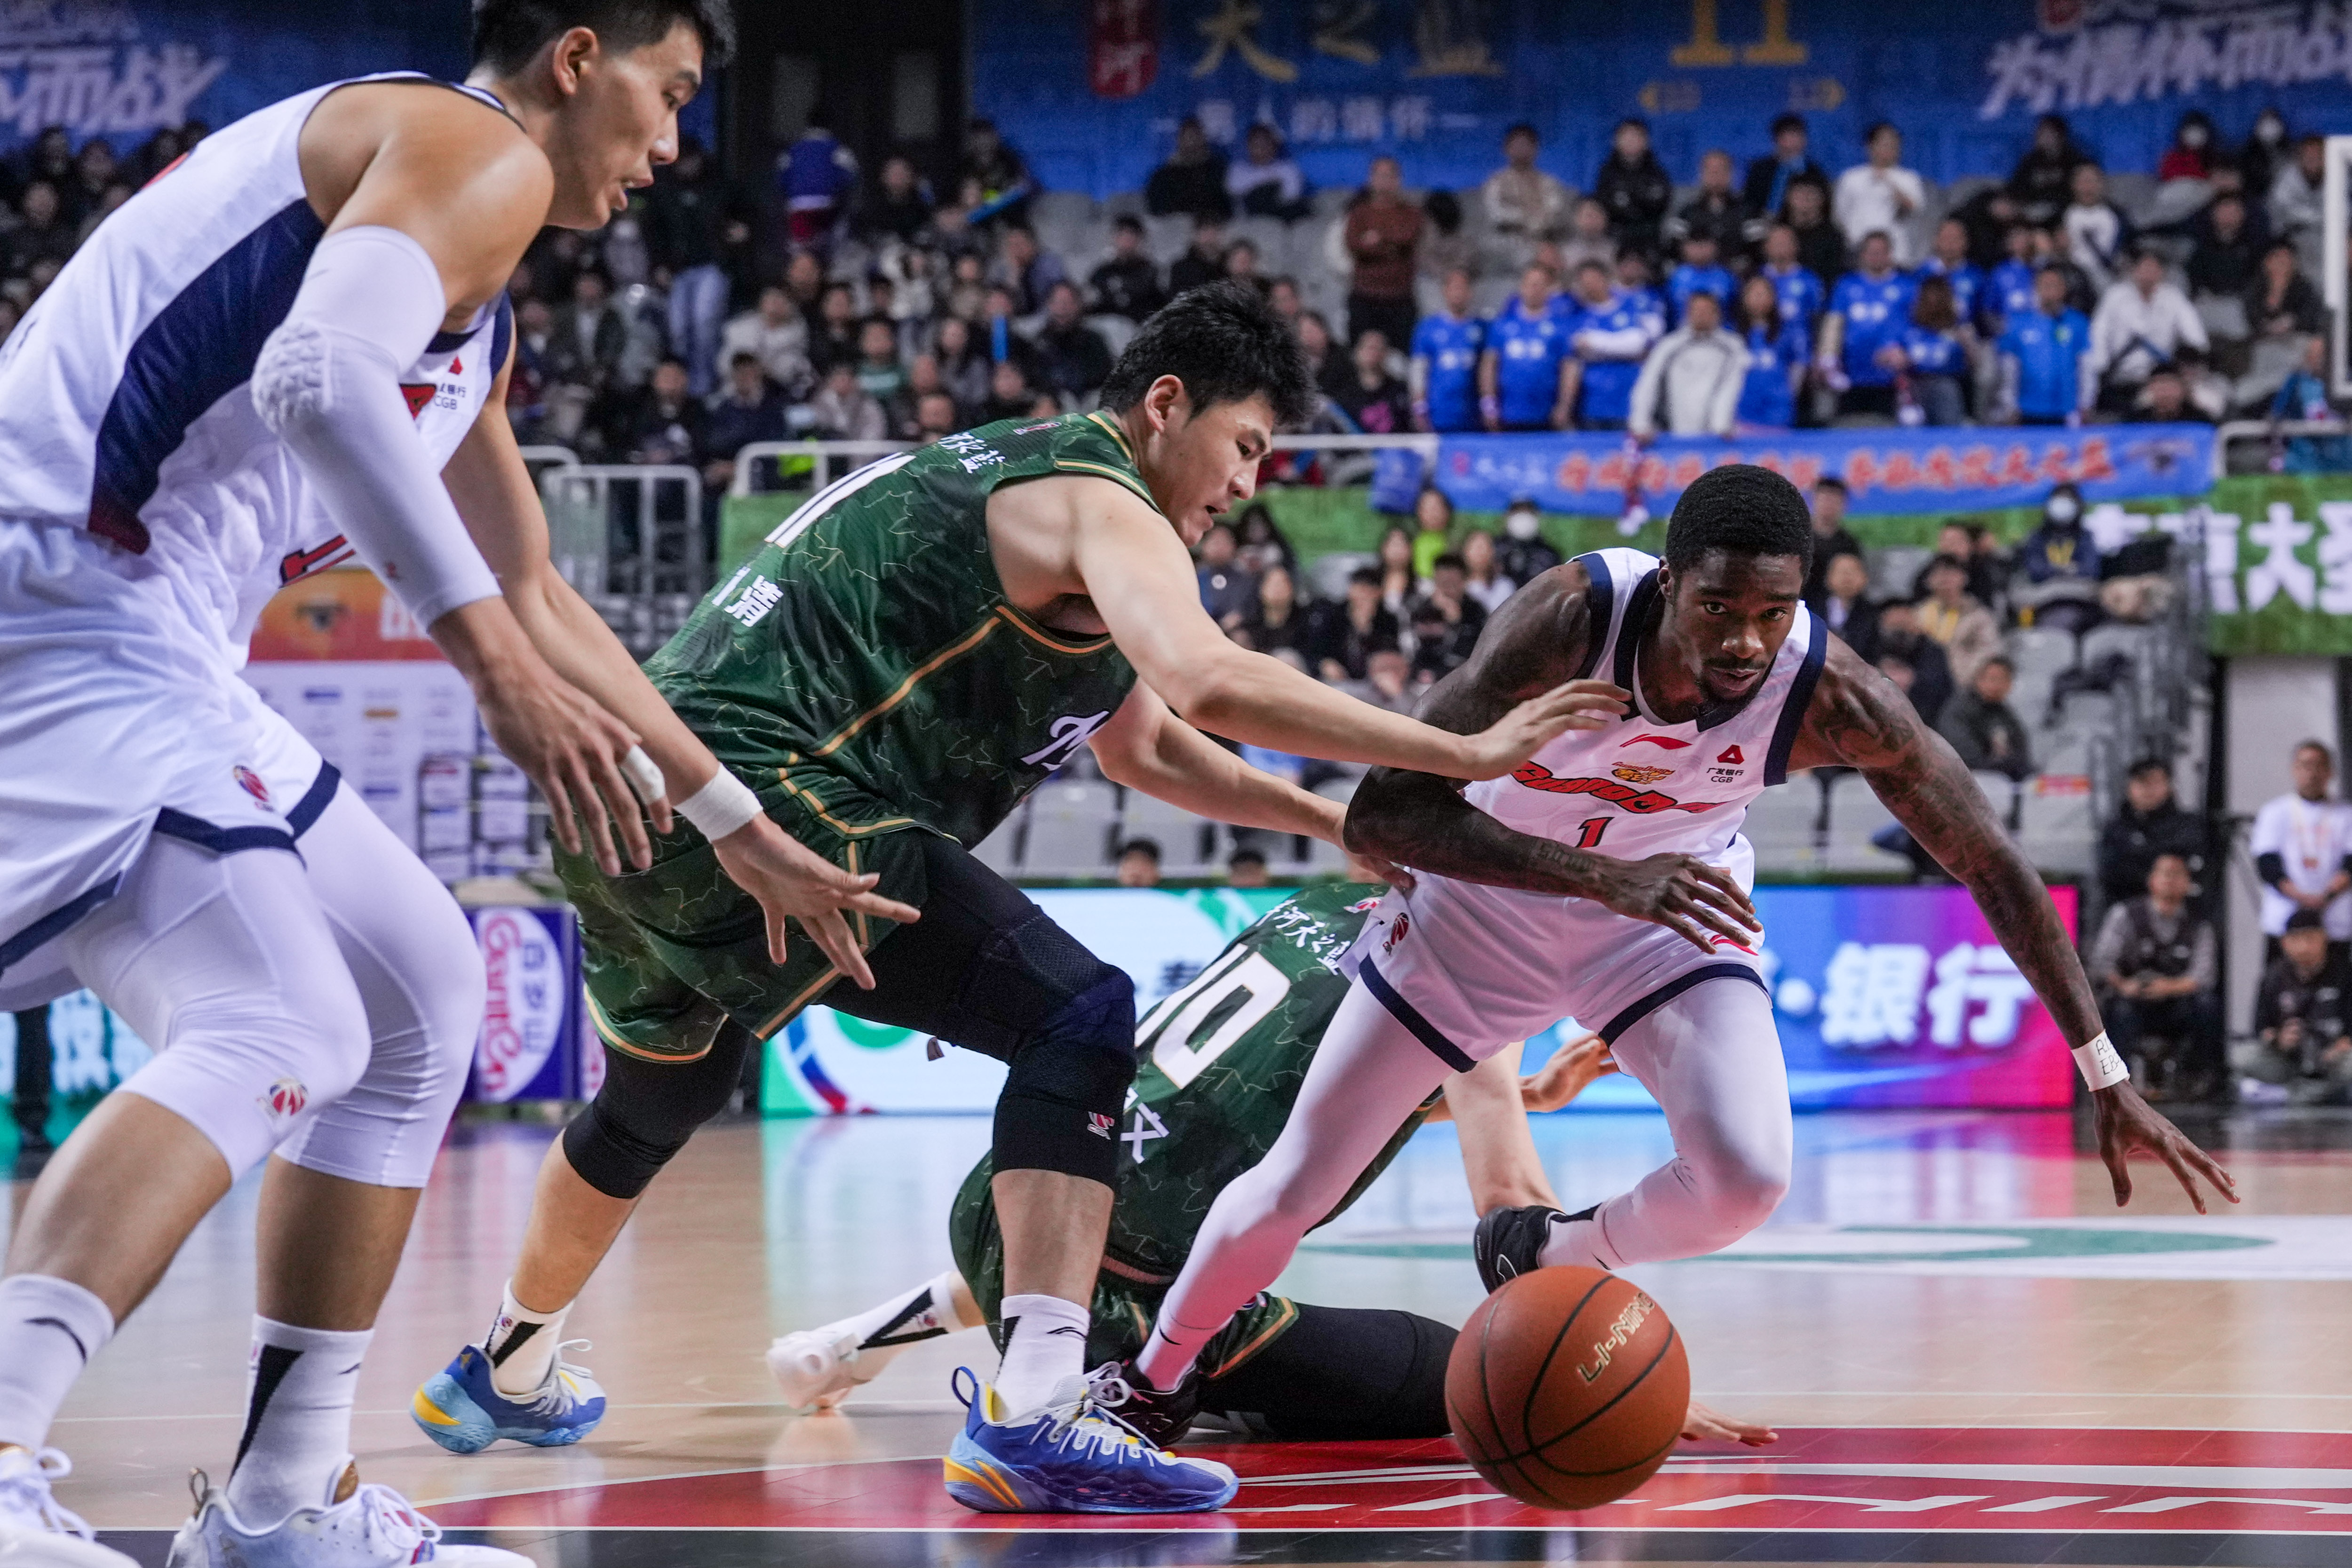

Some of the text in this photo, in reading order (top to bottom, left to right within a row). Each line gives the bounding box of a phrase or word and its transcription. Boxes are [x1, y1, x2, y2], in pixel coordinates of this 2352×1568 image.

[434, 396, 457, 410] CGB
[1706, 767, 1744, 776] 广发银行
[1575, 817, 1614, 848] 1
[1134, 943, 1291, 1090] 10
[1760, 939, 2038, 1048] 银行
[1120, 1087, 1170, 1164] 文
[1577, 1292, 1655, 1385] LI-NING
